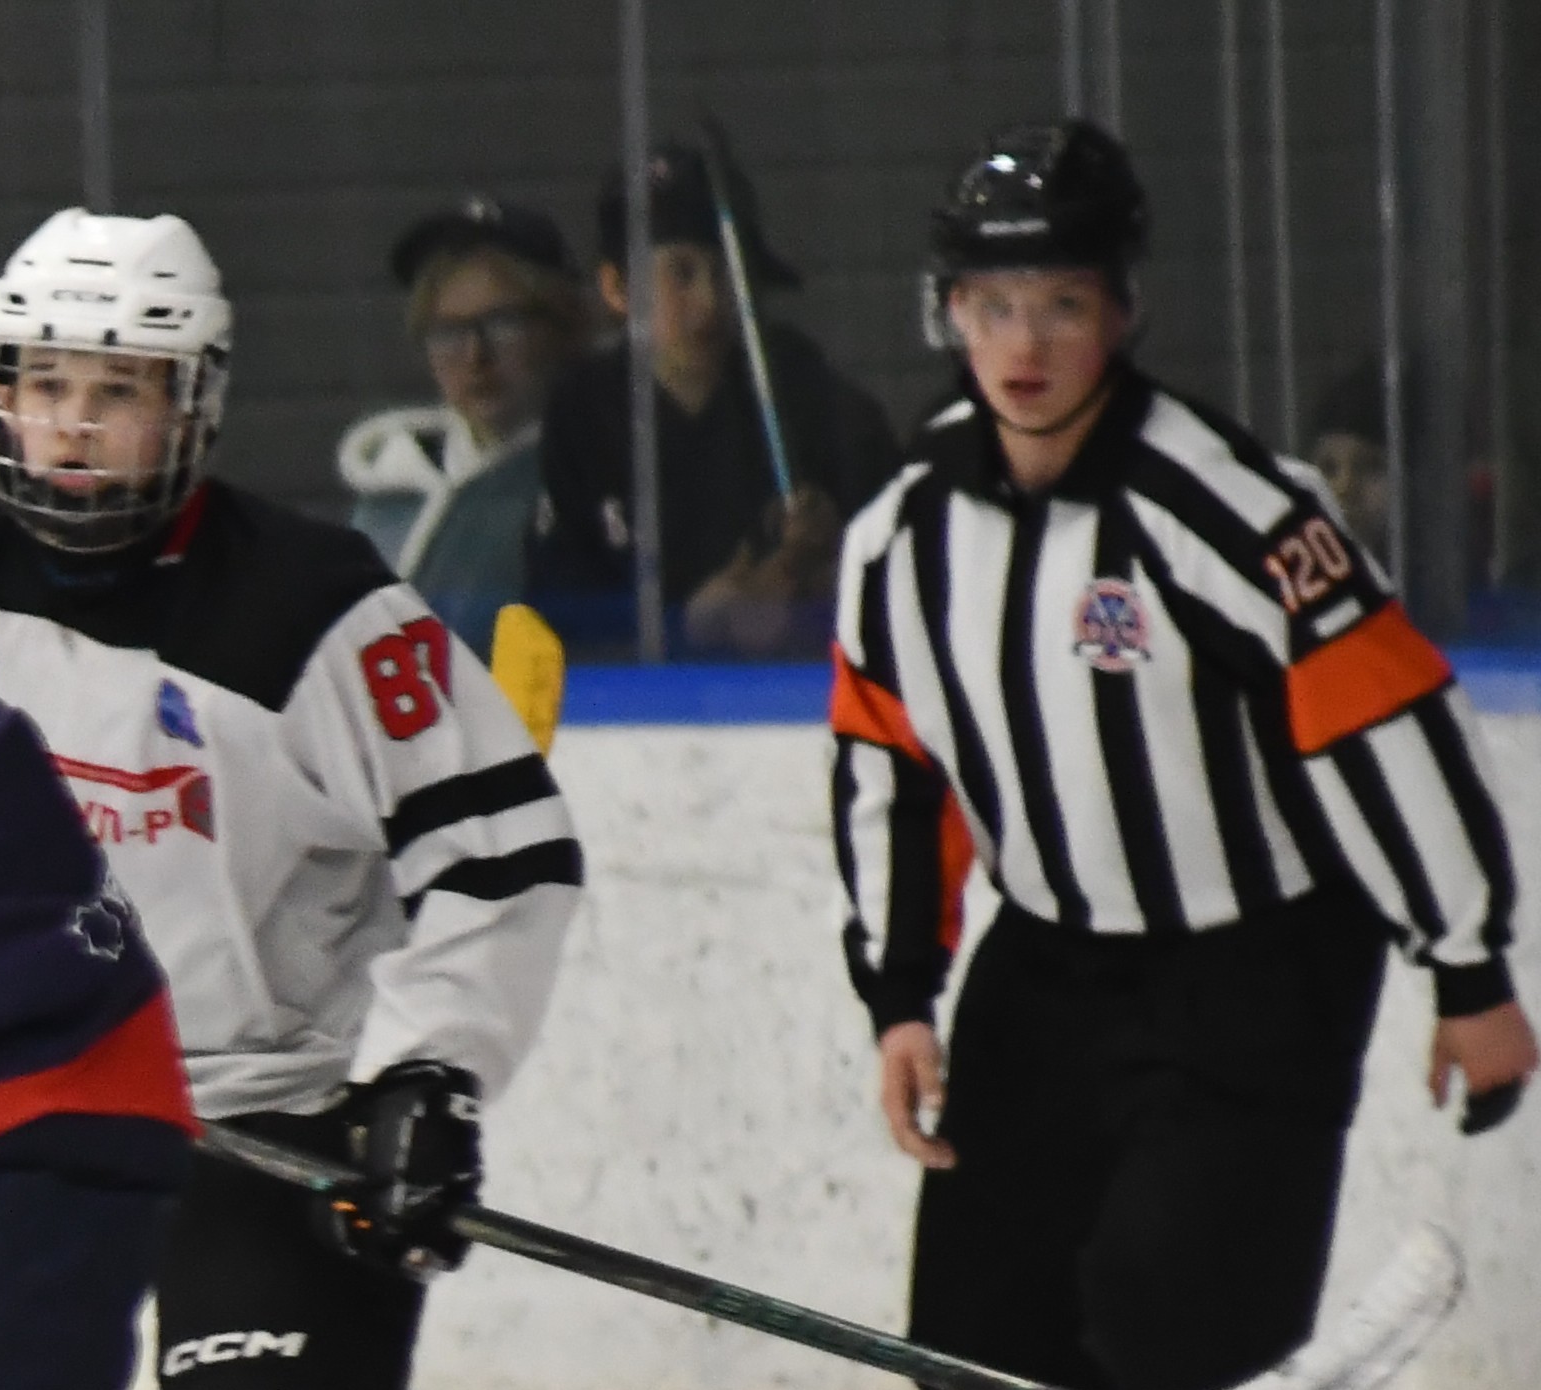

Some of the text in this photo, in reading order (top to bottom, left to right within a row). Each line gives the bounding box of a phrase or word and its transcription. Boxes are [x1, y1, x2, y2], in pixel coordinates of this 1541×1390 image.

[1264, 518, 1351, 616] 120
[359, 616, 453, 742] 87
[162, 1330, 308, 1376] CCM
